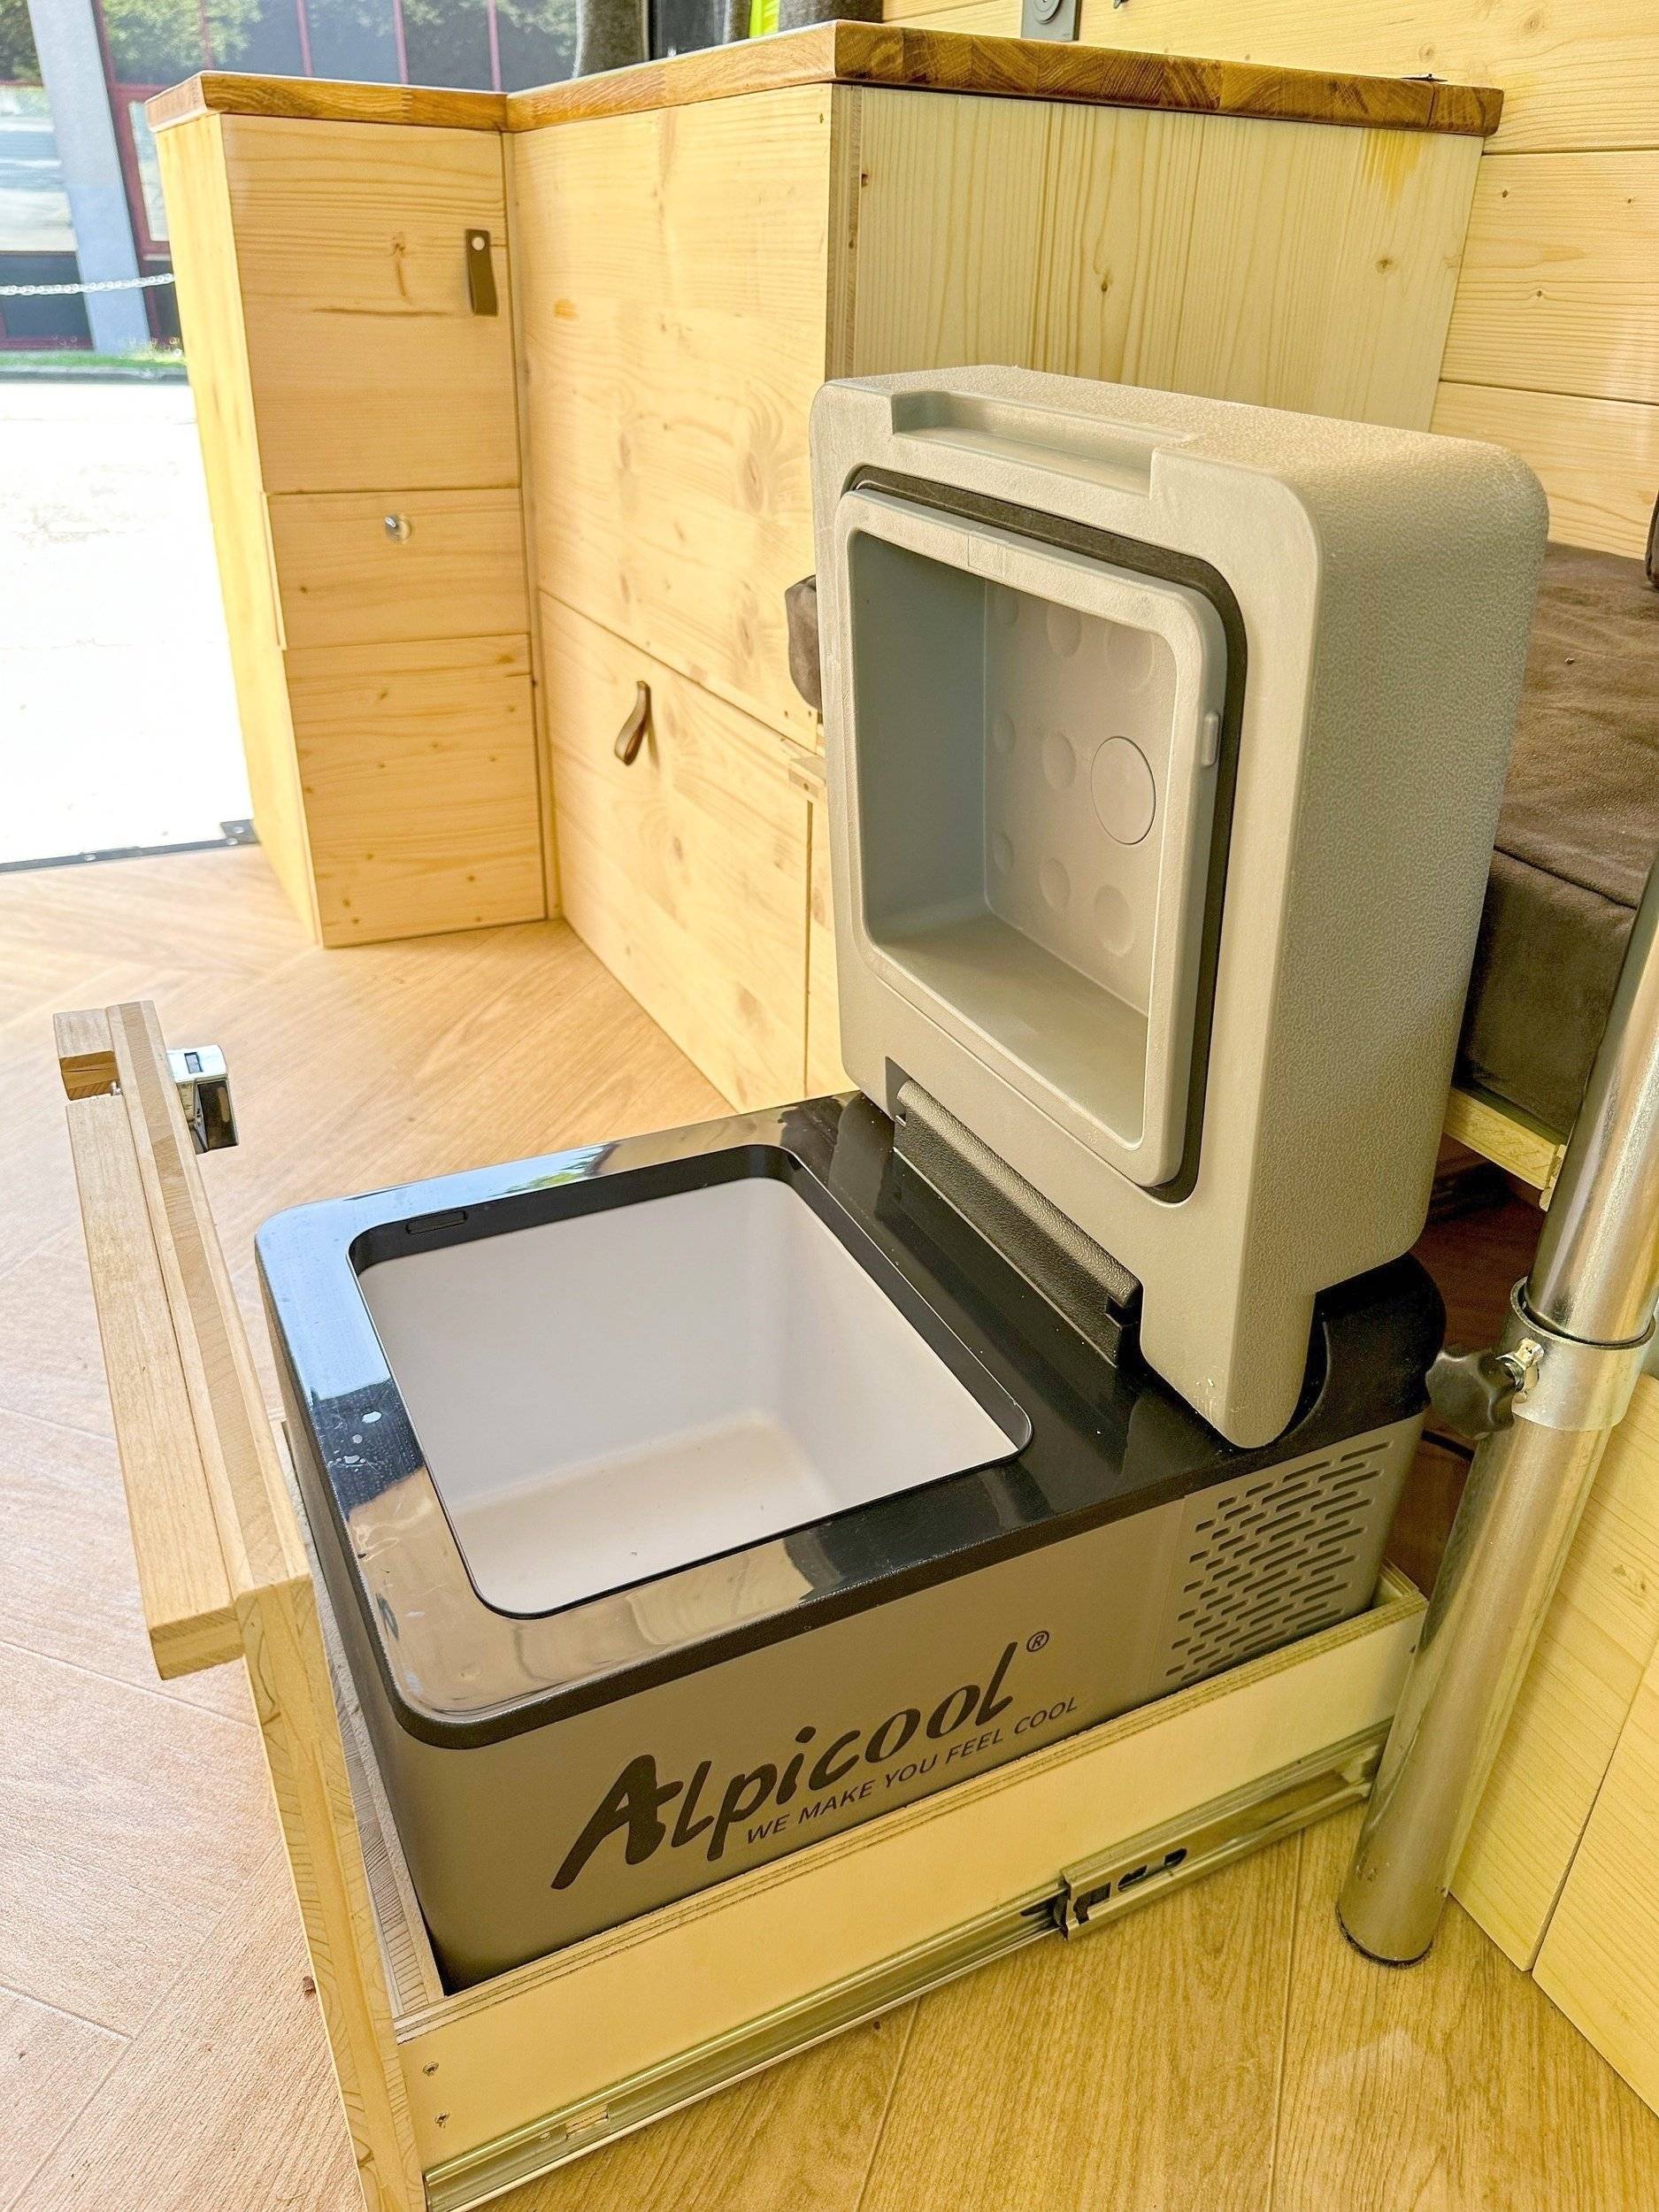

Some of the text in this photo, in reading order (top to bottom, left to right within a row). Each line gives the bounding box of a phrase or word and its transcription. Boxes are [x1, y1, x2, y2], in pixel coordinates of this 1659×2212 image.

[748, 1696, 1078, 1845] WE MAKE YOU FEEL COOL
